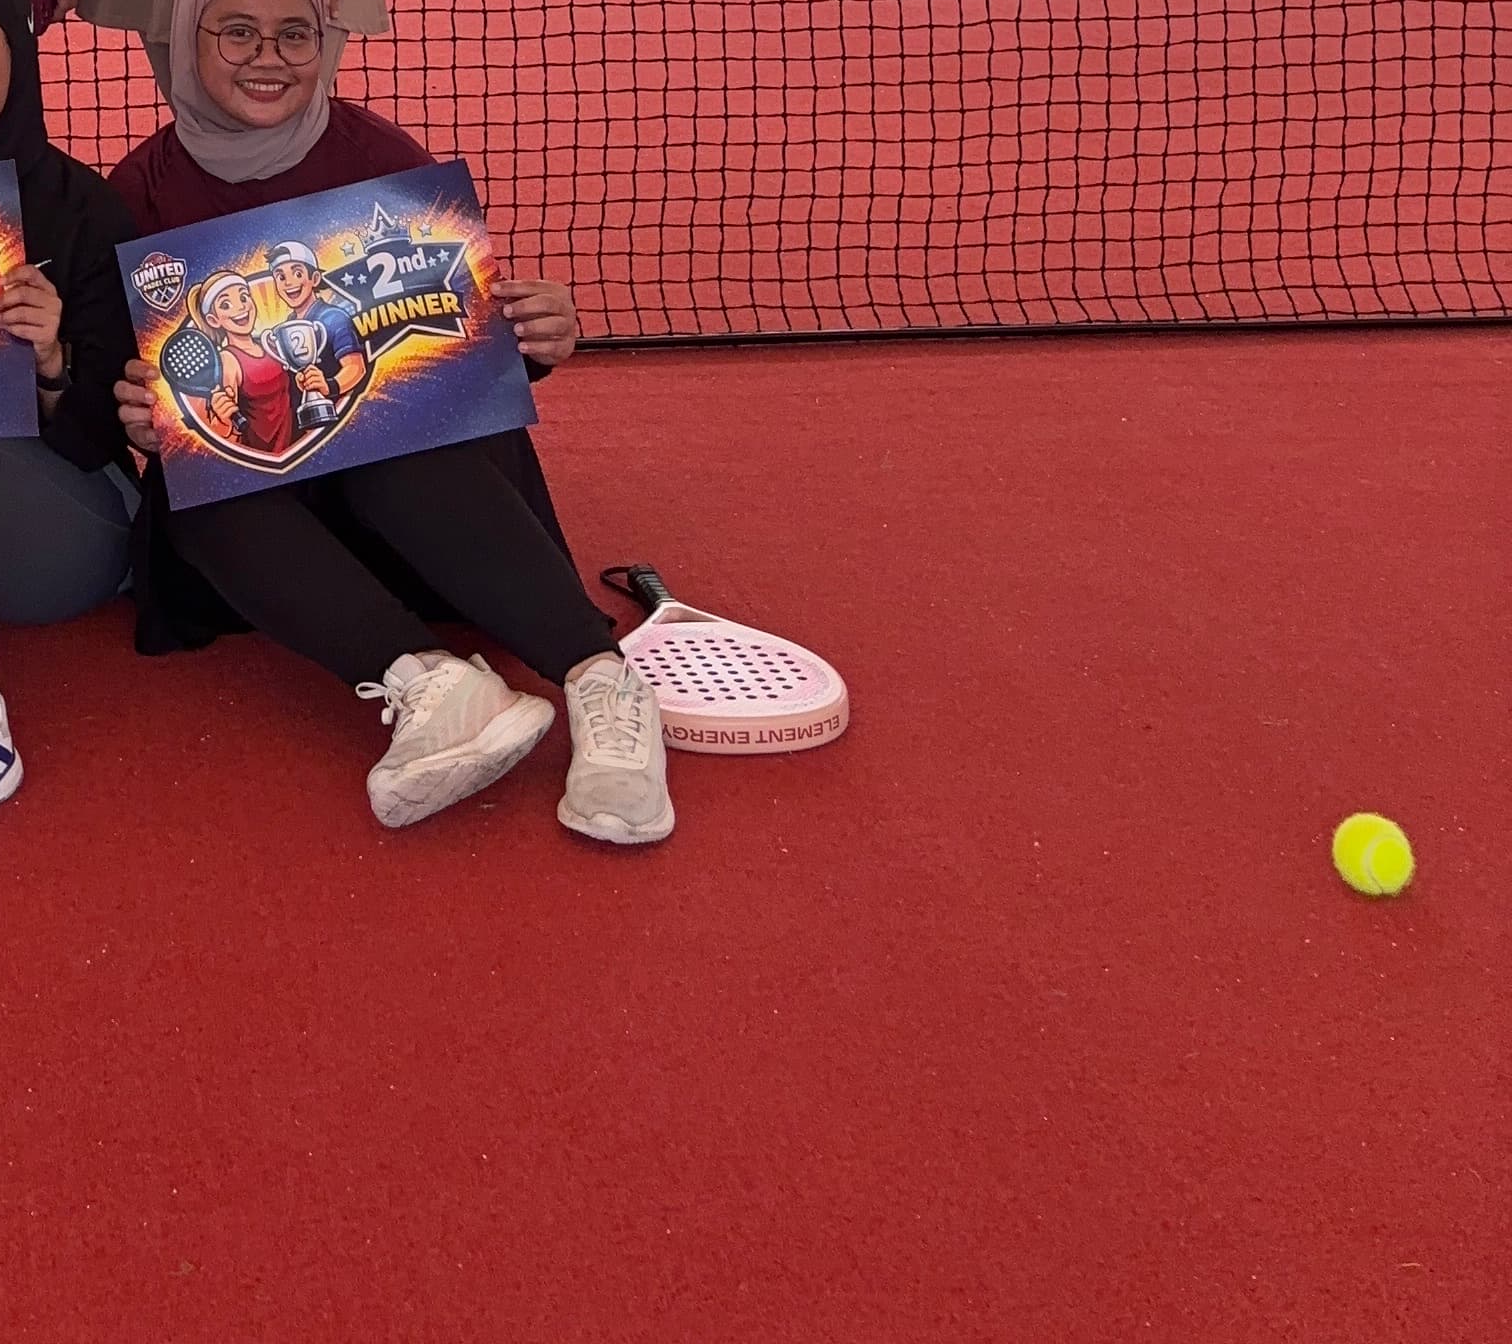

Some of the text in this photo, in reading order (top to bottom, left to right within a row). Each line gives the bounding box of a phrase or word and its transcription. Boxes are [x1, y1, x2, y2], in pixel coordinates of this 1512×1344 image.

[134, 262, 185, 287] UNITED
[143, 276, 180, 291] PADEL CLUB
[366, 248, 428, 299] 2nd
[352, 292, 461, 337] WINNER
[290, 330, 308, 357] 2
[662, 715, 840, 744] ELEMENT ENERGY
